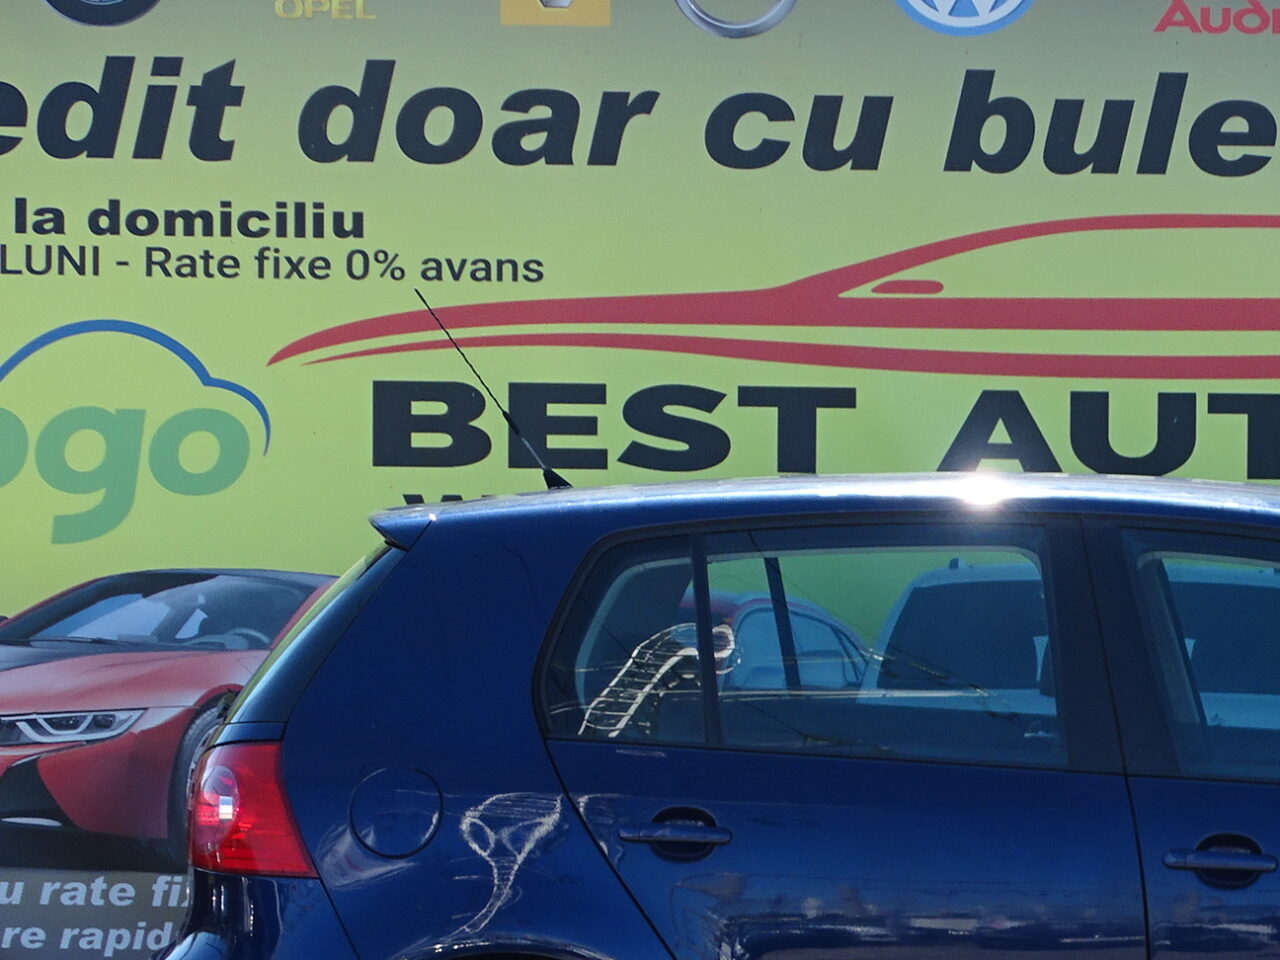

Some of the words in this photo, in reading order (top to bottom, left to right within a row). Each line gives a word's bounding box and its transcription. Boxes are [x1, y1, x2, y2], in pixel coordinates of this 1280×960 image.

[298, 59, 661, 167] doar
[704, 92, 895, 172] cu
[14, 197, 66, 236] la
[87, 198, 364, 239] domiciliu
[0, 244, 100, 277] LUNI
[145, 246, 241, 279] Rate
[254, 246, 332, 280] fixe
[346, 249, 406, 281] 0%
[420, 257, 544, 283] avans
[372, 379, 858, 474] BEST
[0, 405, 250, 544] go
[40, 875, 136, 907] rate
[1, 926, 46, 949] re
[60, 921, 180, 957] rapid
